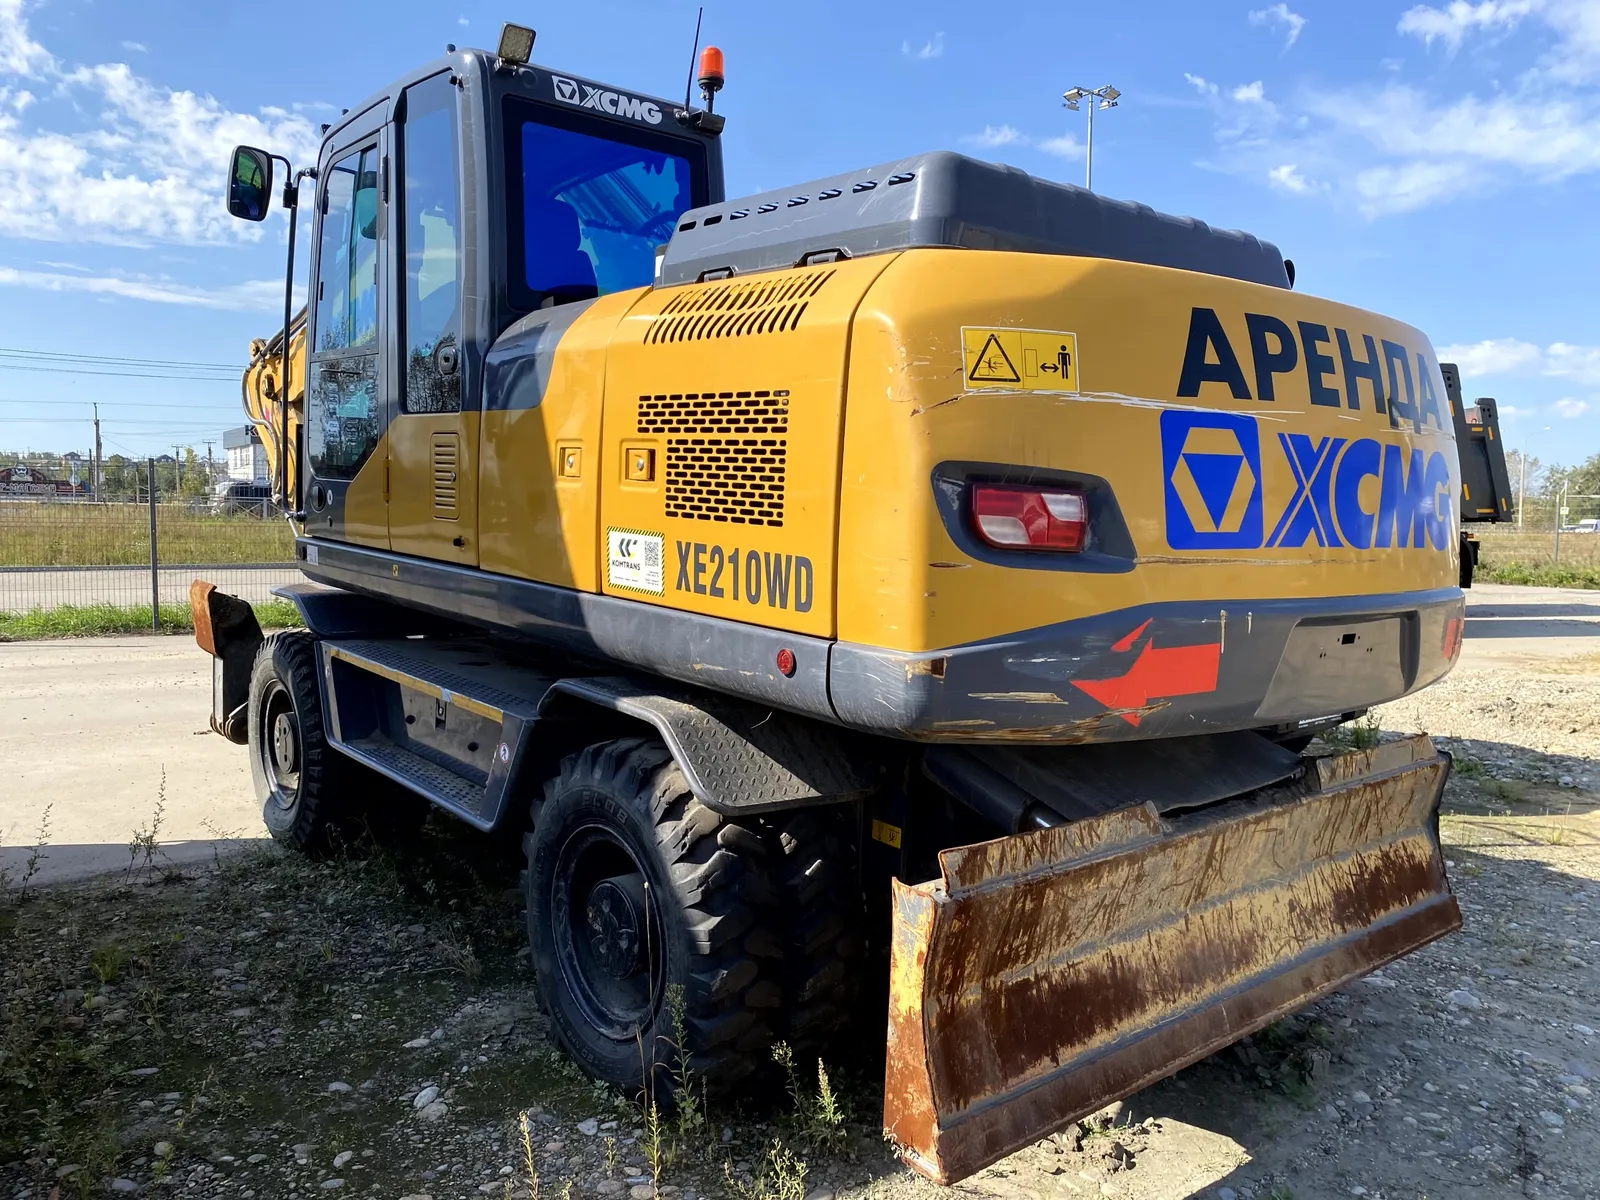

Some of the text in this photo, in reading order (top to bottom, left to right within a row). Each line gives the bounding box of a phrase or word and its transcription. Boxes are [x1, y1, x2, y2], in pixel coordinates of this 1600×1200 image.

[580, 84, 662, 124] XCMG
[1176, 307, 1443, 434] АРЕНДА
[1264, 432, 1450, 552] XCMG
[611, 560, 641, 571] KOMTRANS
[675, 540, 813, 613] XE210WD
